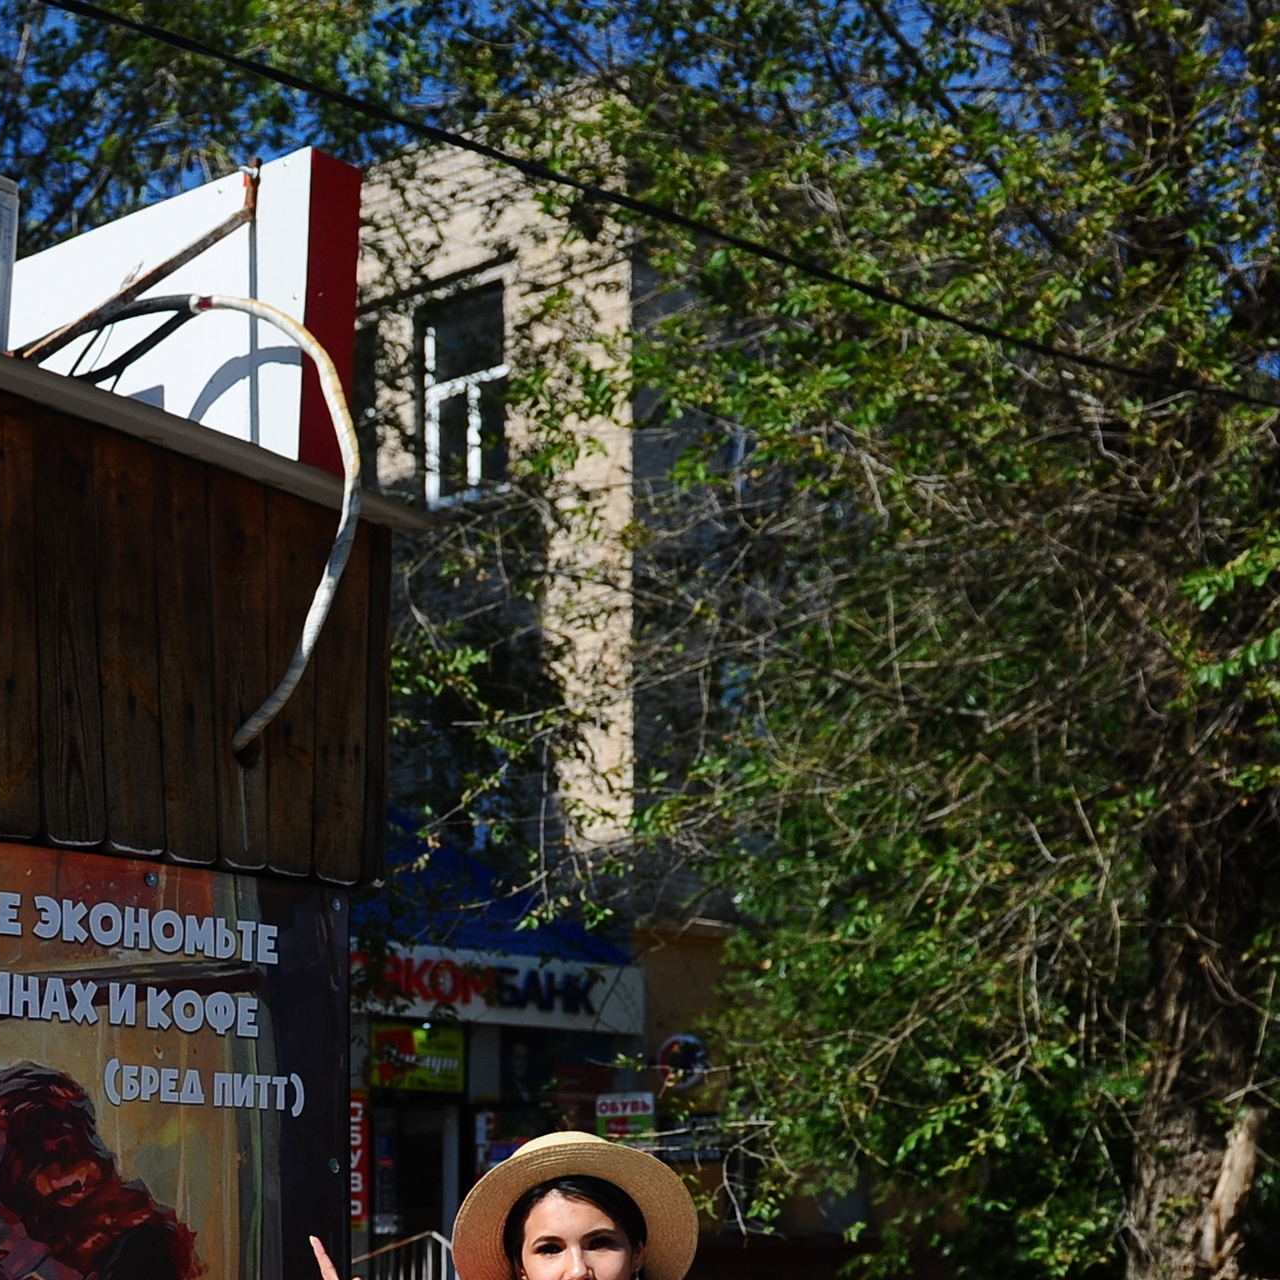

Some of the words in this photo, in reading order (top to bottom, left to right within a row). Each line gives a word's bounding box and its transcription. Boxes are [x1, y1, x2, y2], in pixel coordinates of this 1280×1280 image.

[32, 894, 280, 965] ЭКОНОМЬТЕ
[108, 982, 137, 1027] И
[146, 986, 260, 1038] КОФЕ
[103, 1057, 205, 1106] (БРЕД
[213, 1071, 306, 1118] ПИТТ)
[598, 1100, 651, 1114] ОБУВЬ
